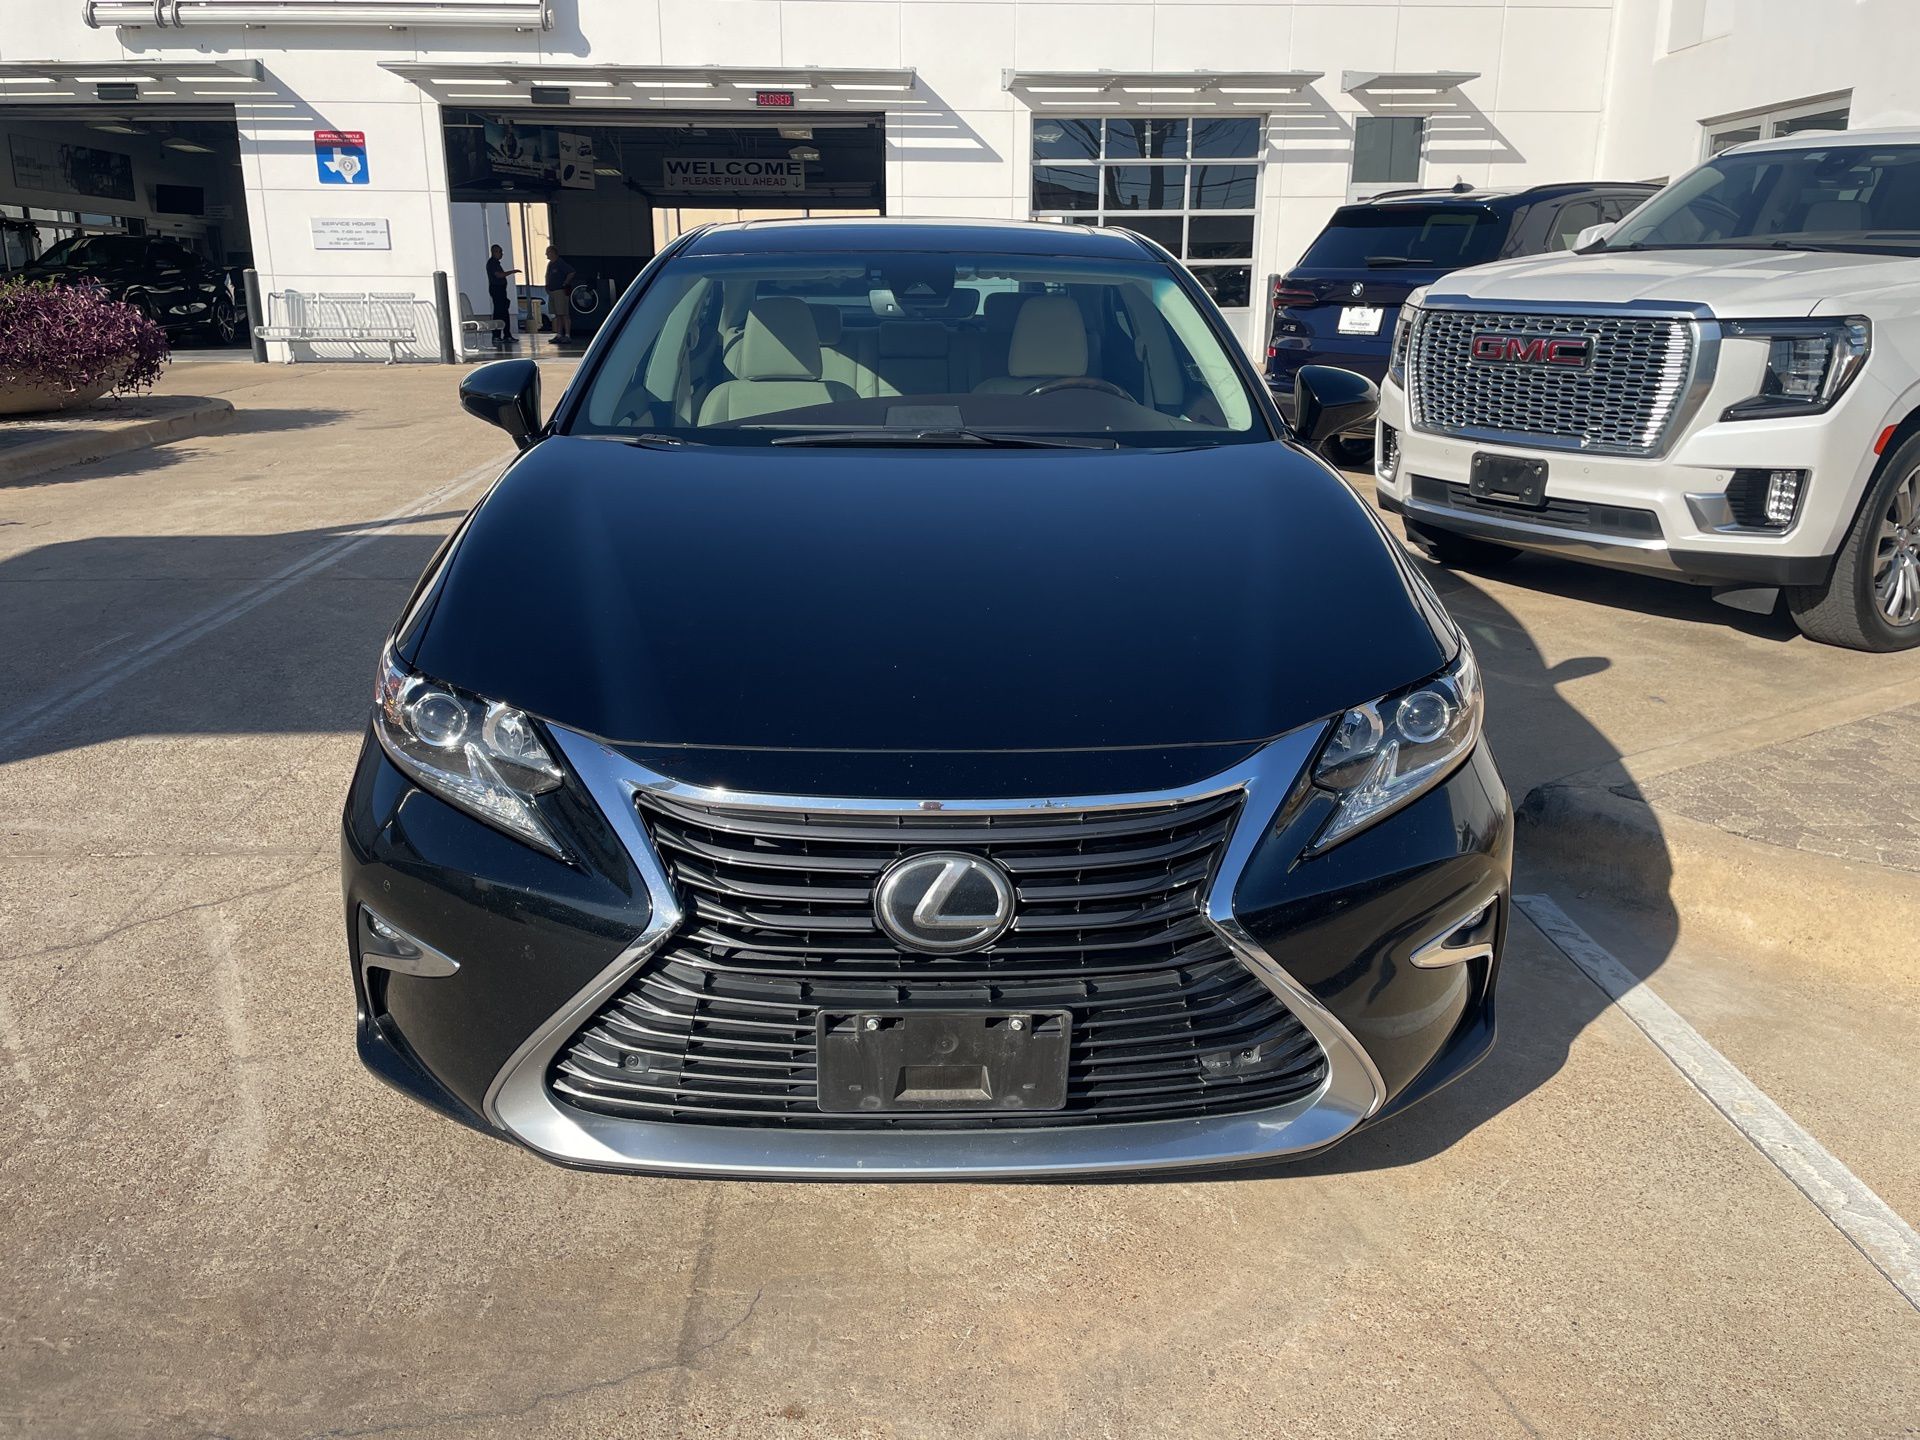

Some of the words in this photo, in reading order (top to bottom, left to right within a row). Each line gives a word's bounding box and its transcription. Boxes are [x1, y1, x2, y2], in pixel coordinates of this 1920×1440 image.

[759, 94, 791, 105] CLOSED
[666, 160, 802, 176] WELCOME
[682, 176, 722, 186] PLEASE
[724, 176, 750, 186] PULL
[752, 177, 787, 187] AHEAD
[1472, 336, 1587, 366] GMC
